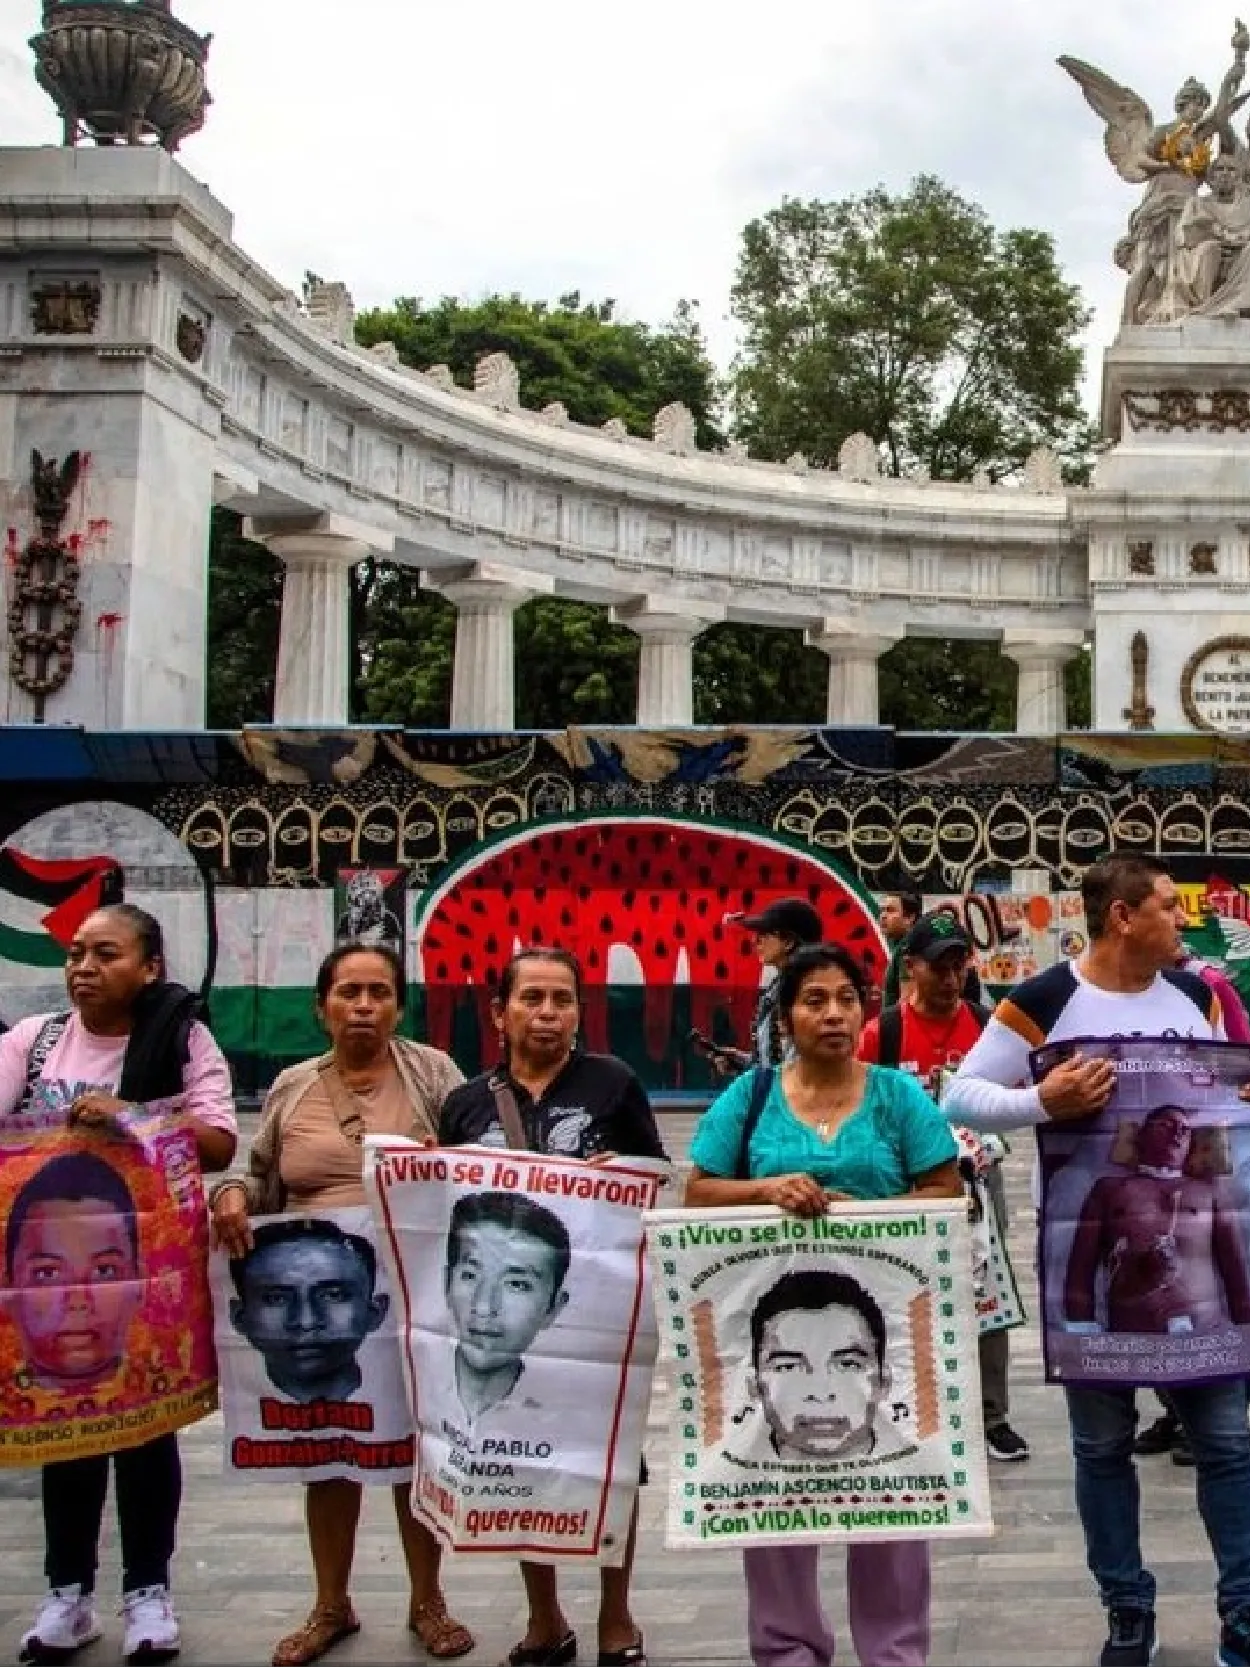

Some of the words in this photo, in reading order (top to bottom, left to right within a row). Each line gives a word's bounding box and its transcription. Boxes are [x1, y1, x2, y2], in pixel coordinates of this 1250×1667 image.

[1195, 691, 1231, 702] BENITO
[1209, 709, 1222, 720] LA
[384, 1155, 447, 1186] ¡Vivo
[453, 1162, 485, 1185] se
[492, 1163, 519, 1188] lo
[527, 1166, 647, 1208] llevaron!
[679, 1222, 743, 1249] ¡Vivo
[750, 1225, 777, 1243] se
[783, 1219, 806, 1238] lo
[812, 1215, 927, 1240] llevaron!
[482, 1438, 554, 1458] PABLO
[480, 1482, 533, 1498] AÑOS
[782, 1476, 863, 1495] ASCENCIO
[870, 1474, 950, 1491] BAUTISTA
[465, 1509, 588, 1537] queremos!
[701, 1513, 749, 1539] ¡Con
[755, 1509, 807, 1530] VIDA
[812, 1508, 832, 1528] lo
[838, 1504, 950, 1531] queremos!
